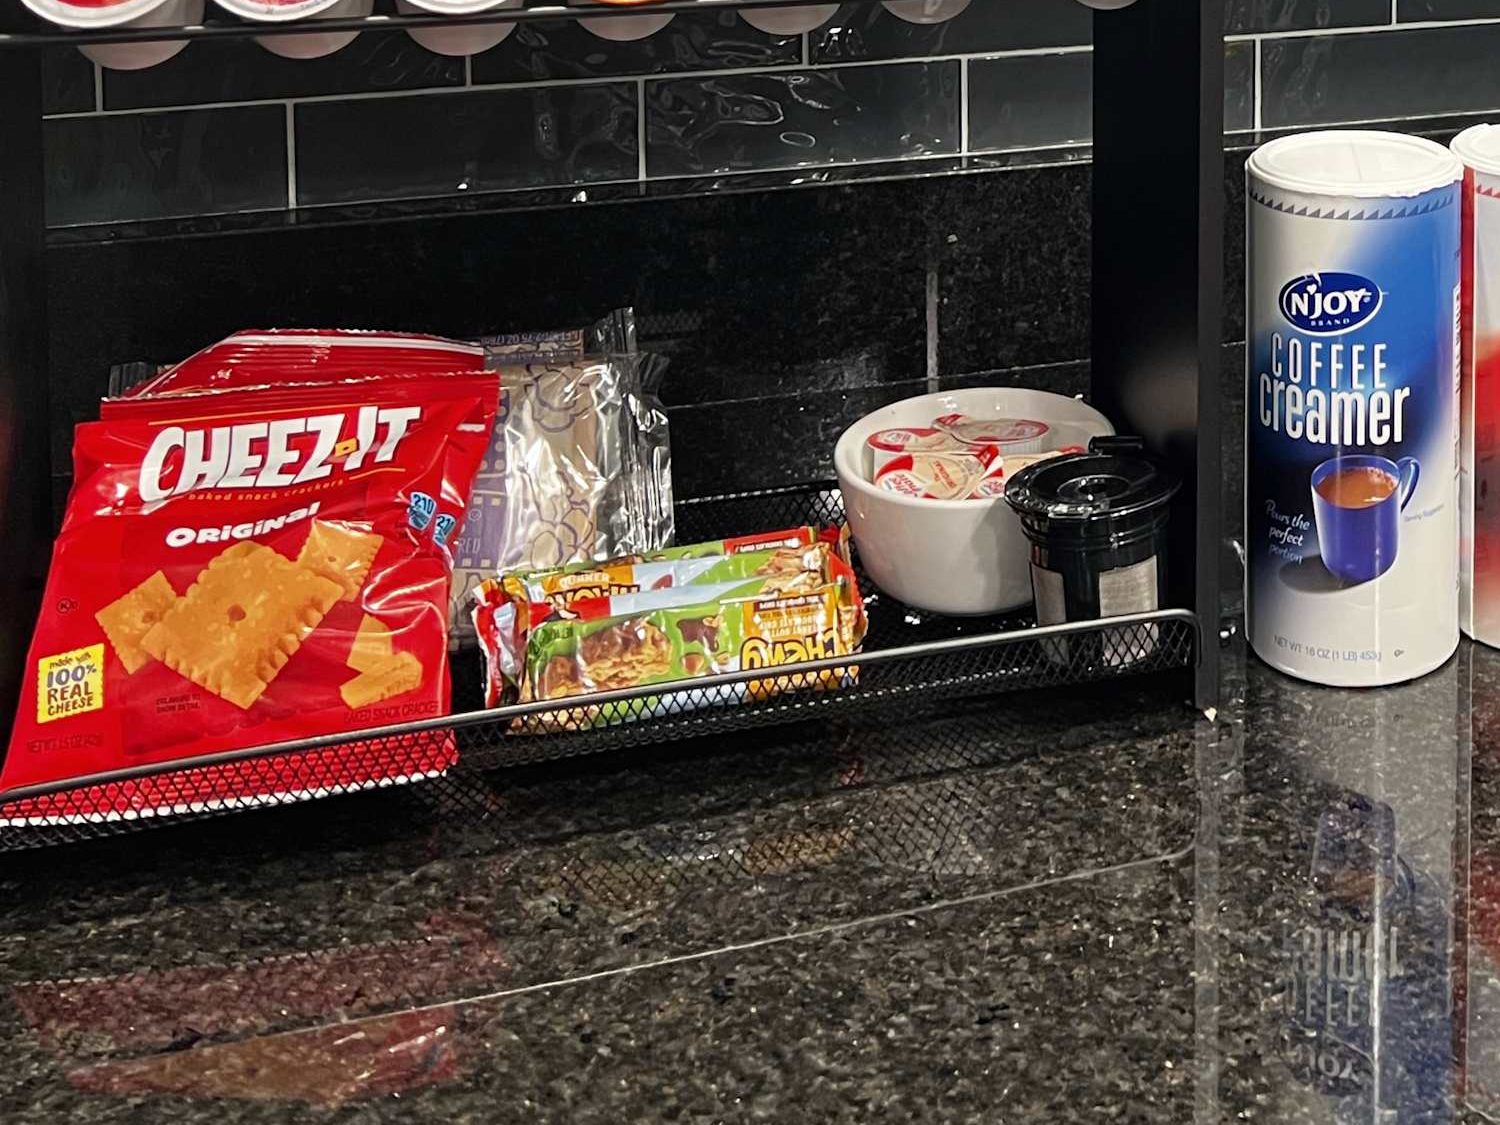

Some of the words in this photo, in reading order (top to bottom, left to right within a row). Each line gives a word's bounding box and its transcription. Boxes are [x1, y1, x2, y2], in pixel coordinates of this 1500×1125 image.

[1310, 317, 1351, 327] BRAND
[1271, 332, 1388, 391] COFFEE
[1259, 373, 1412, 447] creamer
[188, 492, 233, 502] baked
[237, 490, 278, 501] snack
[284, 479, 345, 498] crackers
[412, 493, 435, 516] 210
[1265, 499, 1290, 525] Pours
[1291, 513, 1310, 531] the
[1268, 526, 1305, 547] perfect
[1268, 544, 1304, 564] portion
[1273, 634, 1289, 648] NET
[1317, 648, 1331, 659] OZ
[47, 664, 97, 688] 100%
[47, 681, 93, 705] REAL
[48, 695, 94, 716] CHEESE
